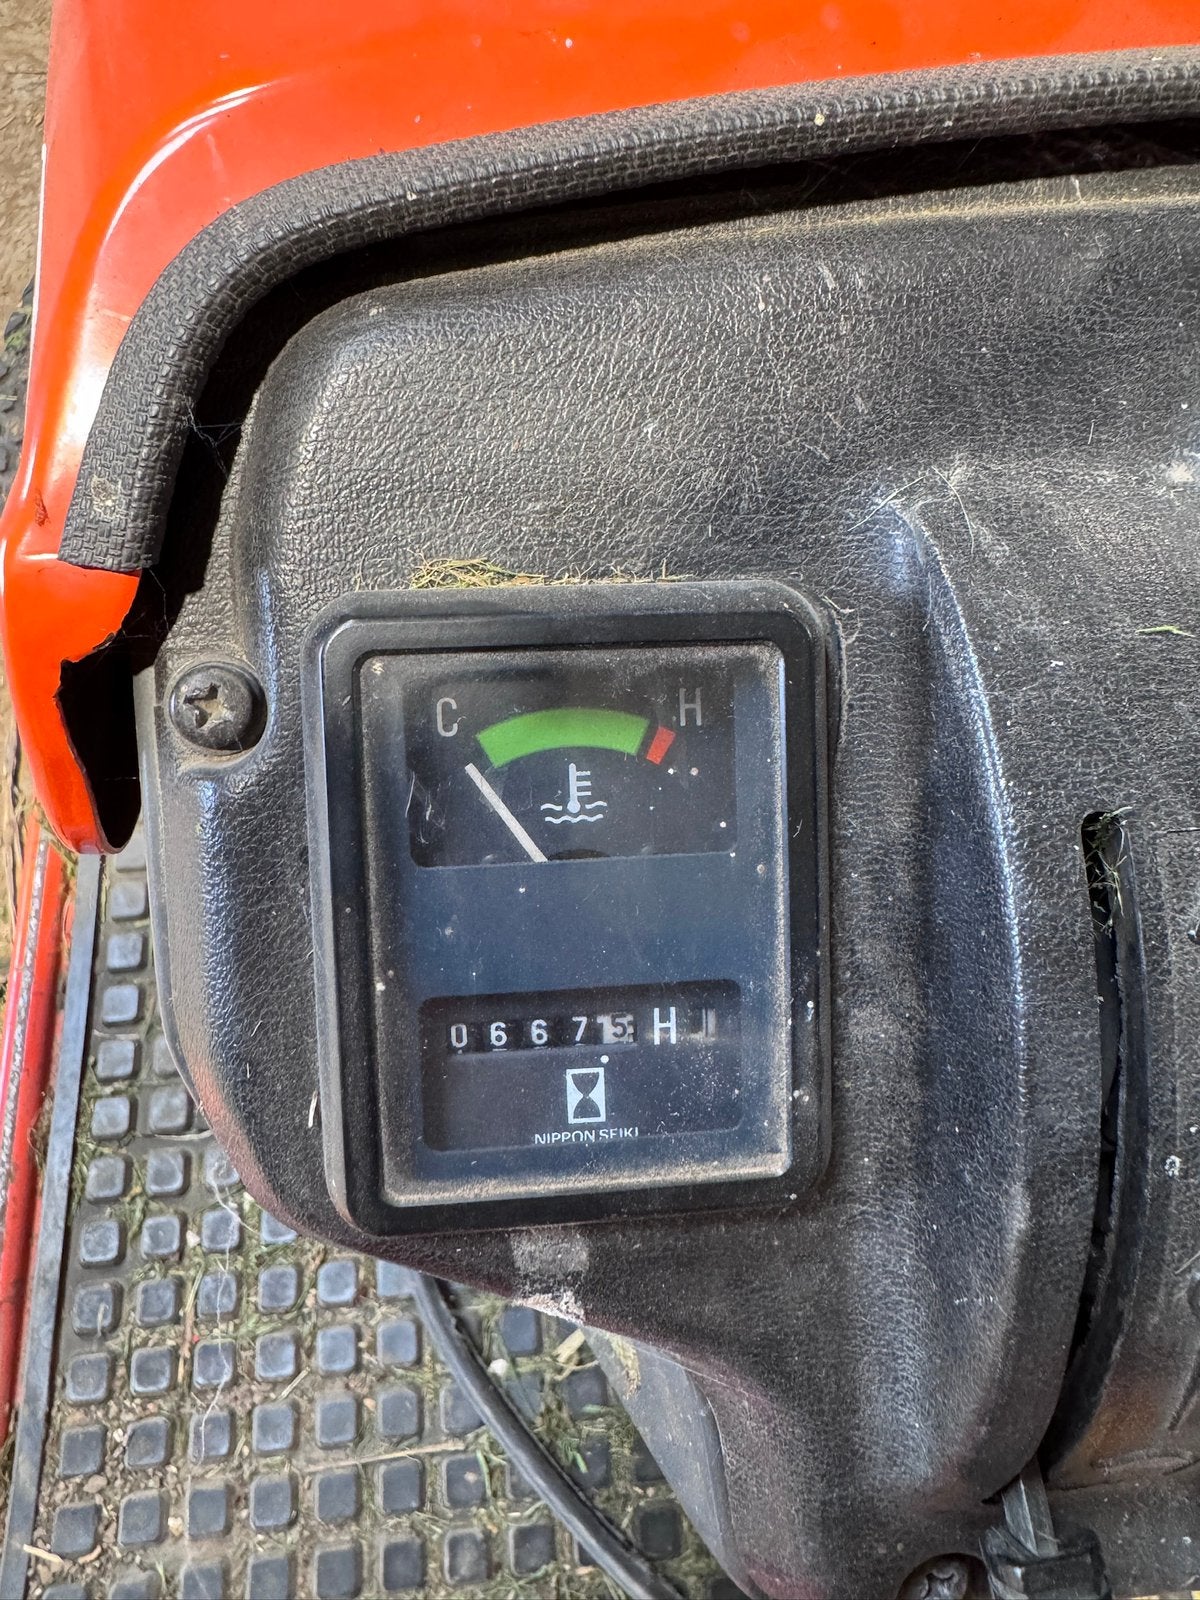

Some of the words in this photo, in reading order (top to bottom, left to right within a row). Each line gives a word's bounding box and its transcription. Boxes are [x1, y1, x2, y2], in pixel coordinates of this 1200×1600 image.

[436, 697, 458, 737] C
[679, 687, 702, 727] H
[653, 1006, 677, 1046] H
[534, 1130, 596, 1145] NIPPON
[599, 1126, 639, 1141] SEIKI
